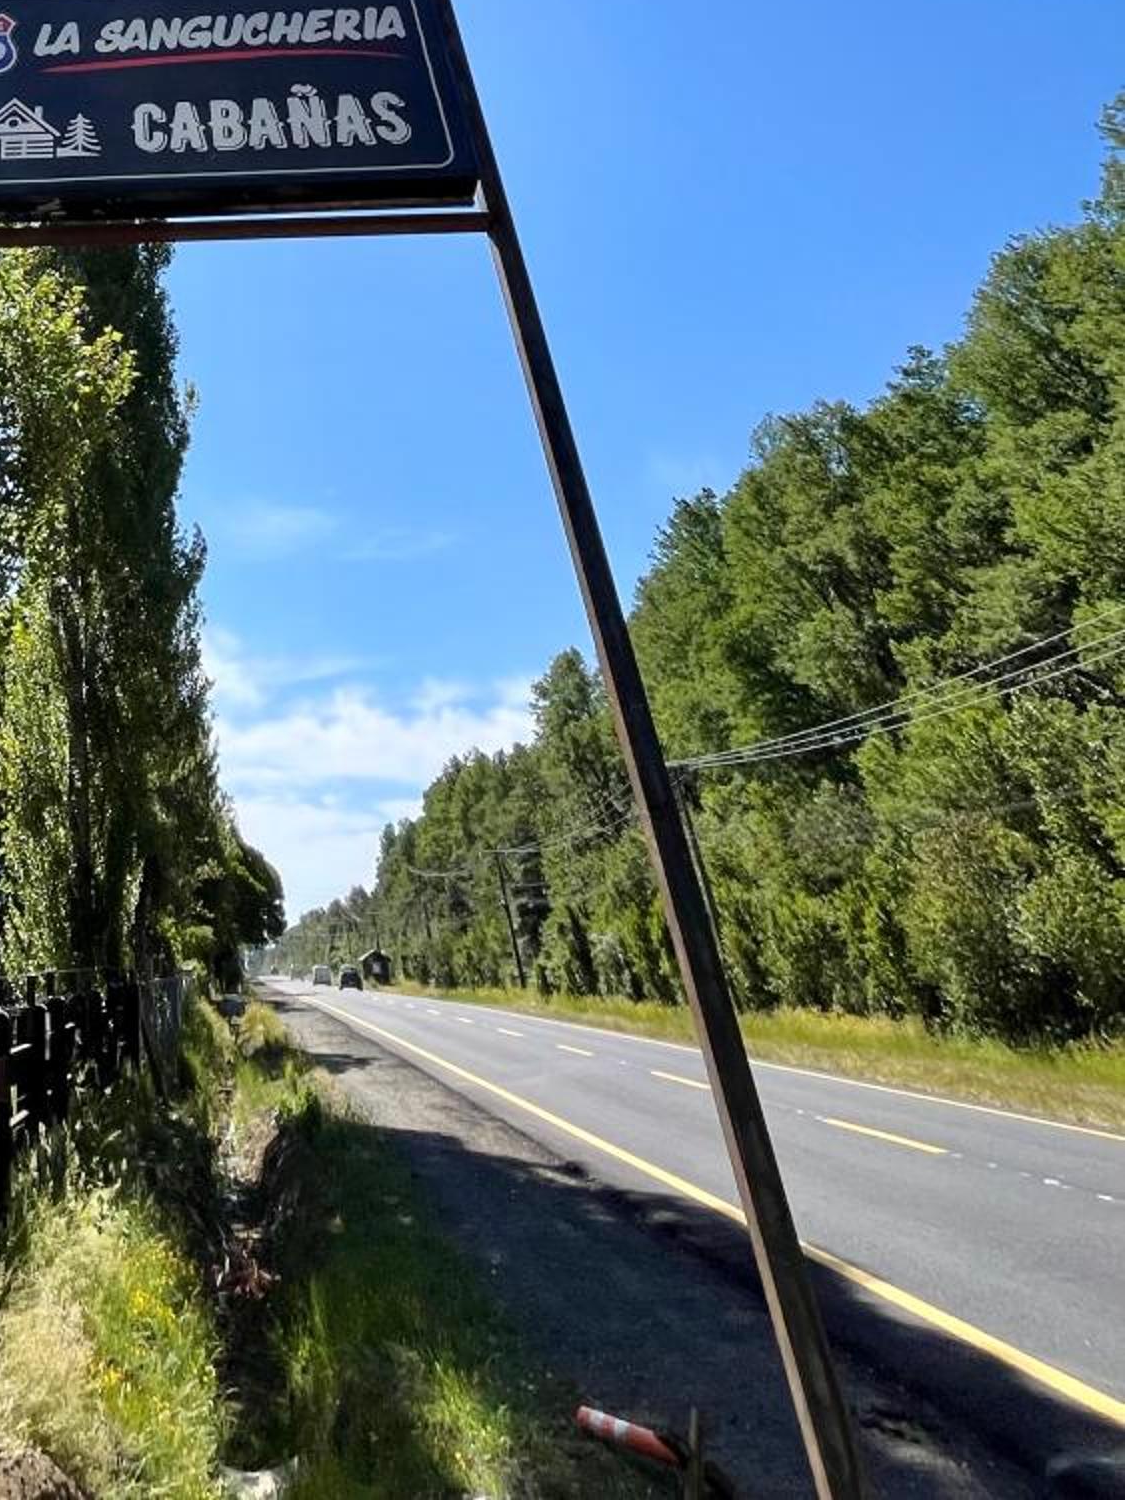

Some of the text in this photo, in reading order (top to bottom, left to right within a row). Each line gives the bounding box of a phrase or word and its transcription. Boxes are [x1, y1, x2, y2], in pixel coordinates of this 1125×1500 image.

[33, 6, 406, 56] LA SANGUCHERIA
[132, 84, 412, 153] CABAÑAS
